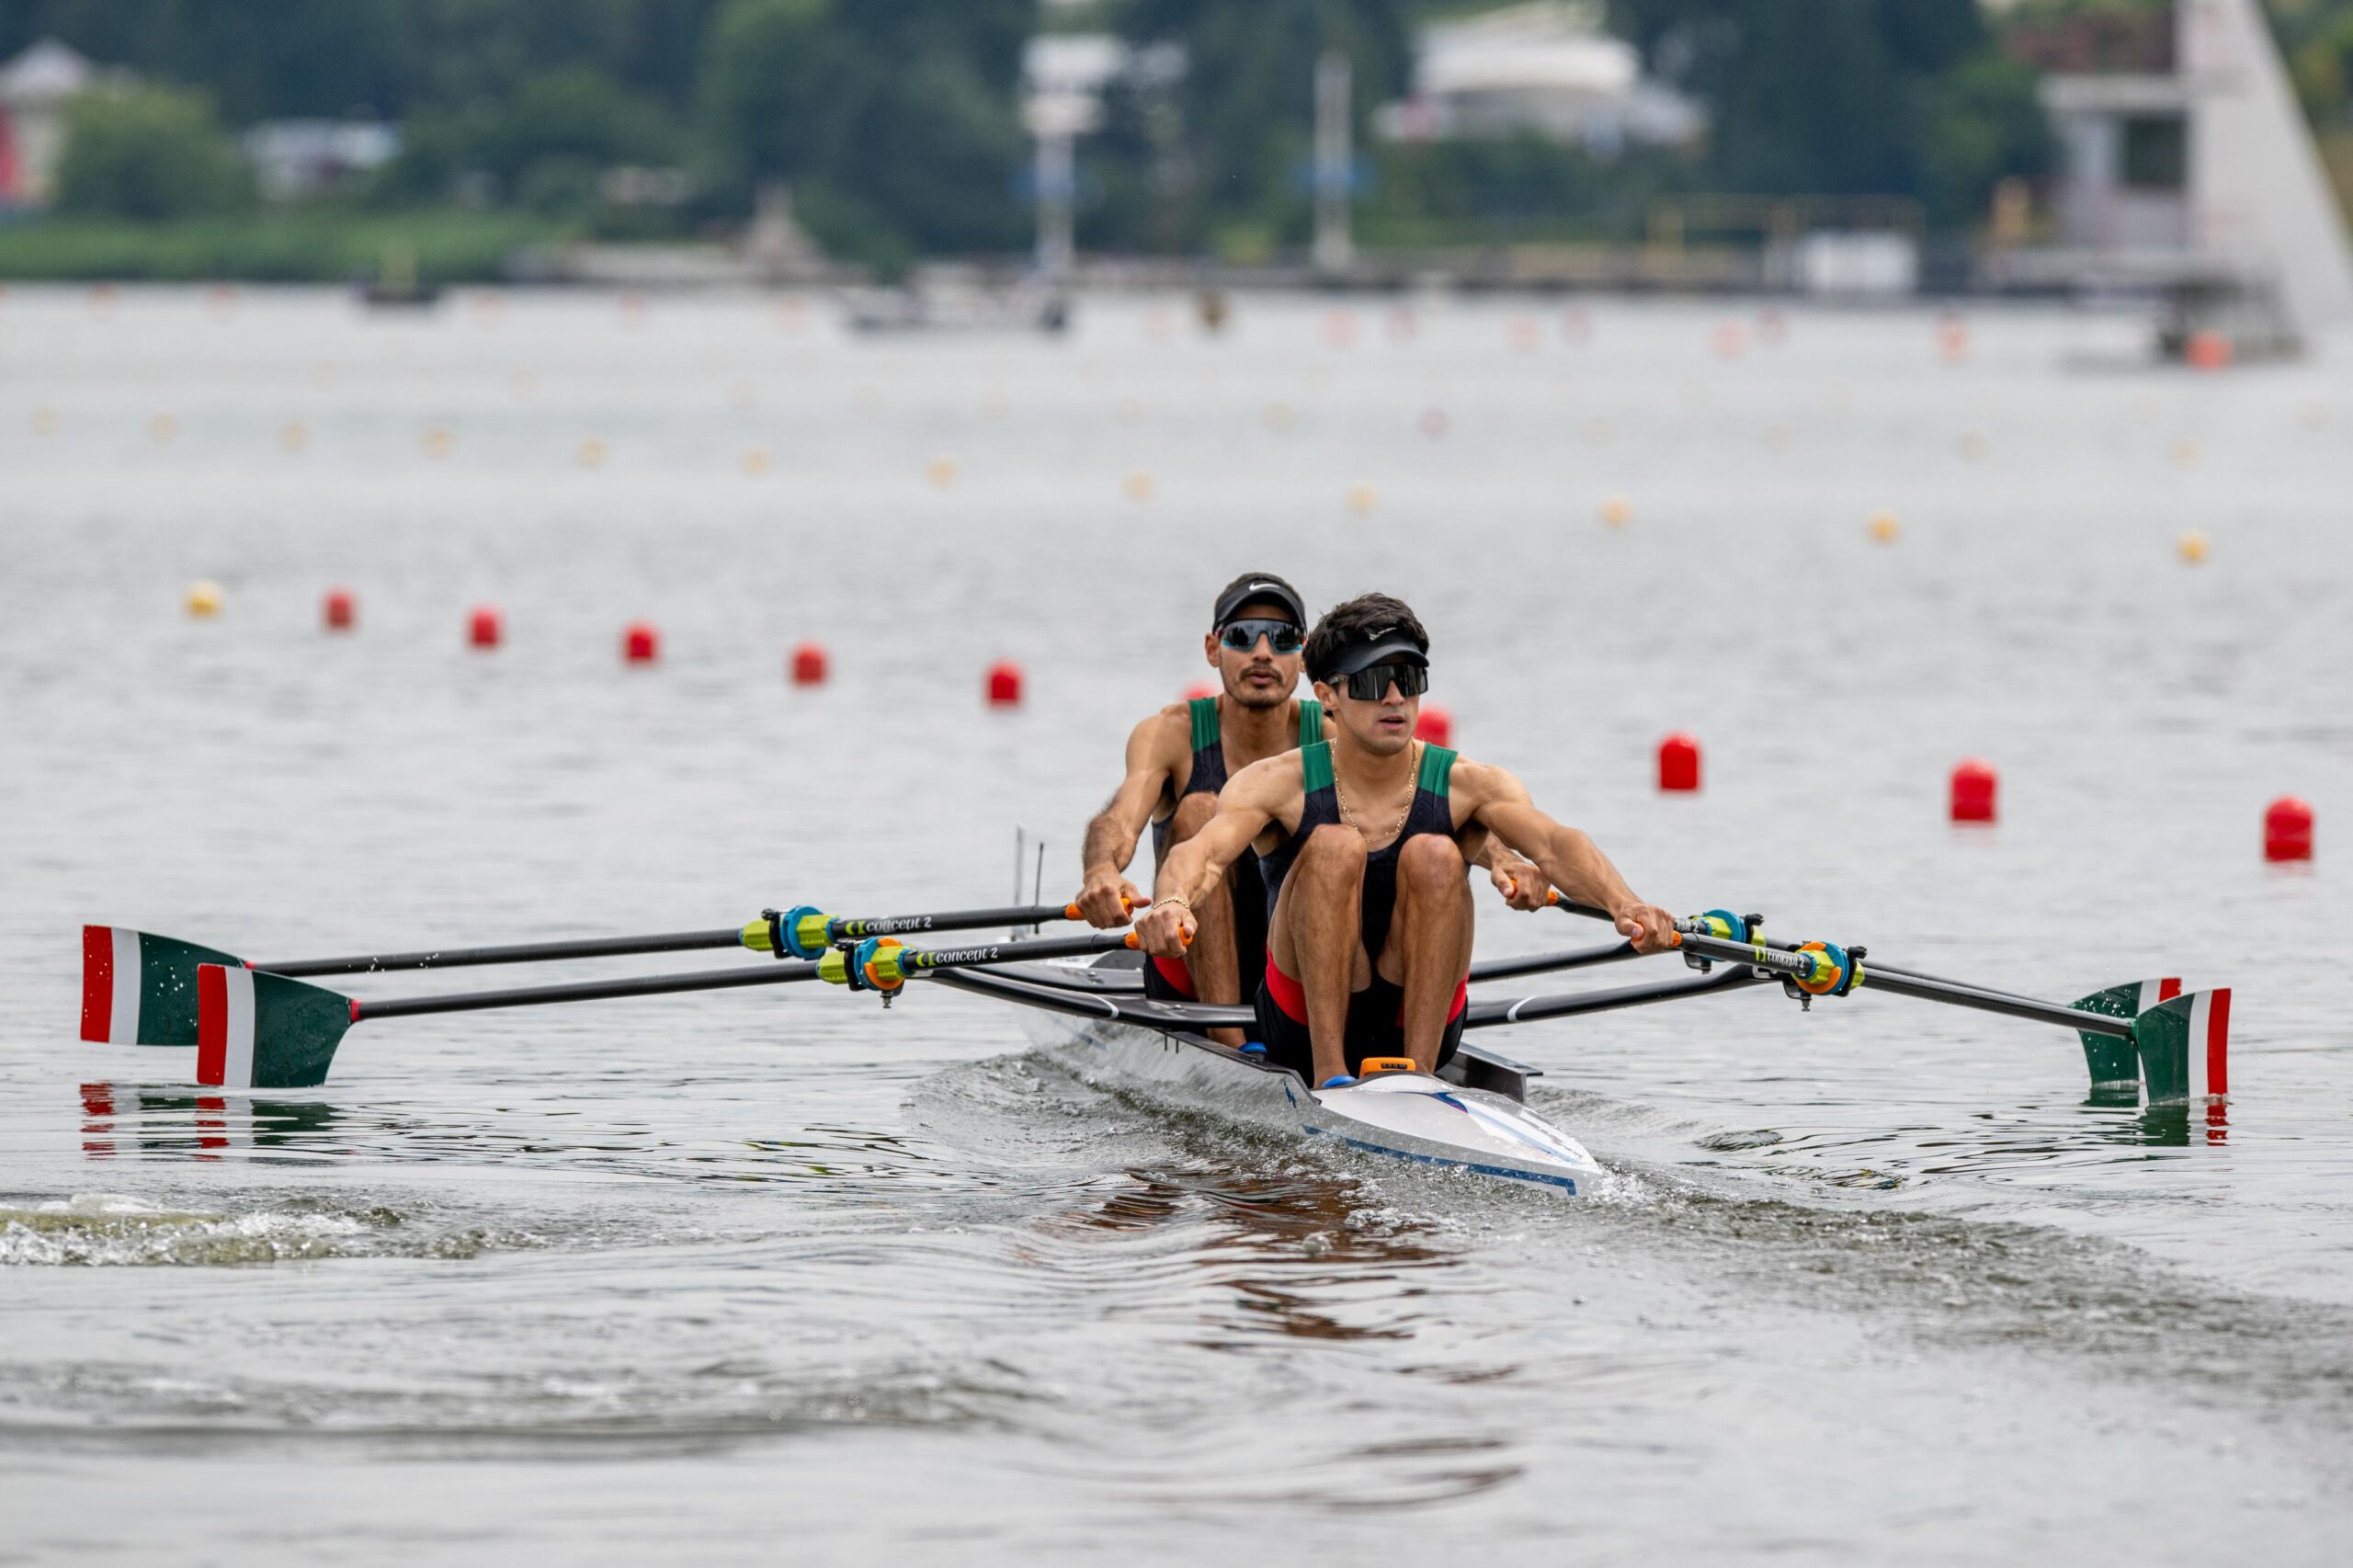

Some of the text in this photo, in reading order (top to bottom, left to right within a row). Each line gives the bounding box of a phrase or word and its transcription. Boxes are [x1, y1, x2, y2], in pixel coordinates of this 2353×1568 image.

[866, 915, 932, 933] concept 2
[936, 947, 998, 964] concept 2
[1767, 950, 1805, 969] concept 2
